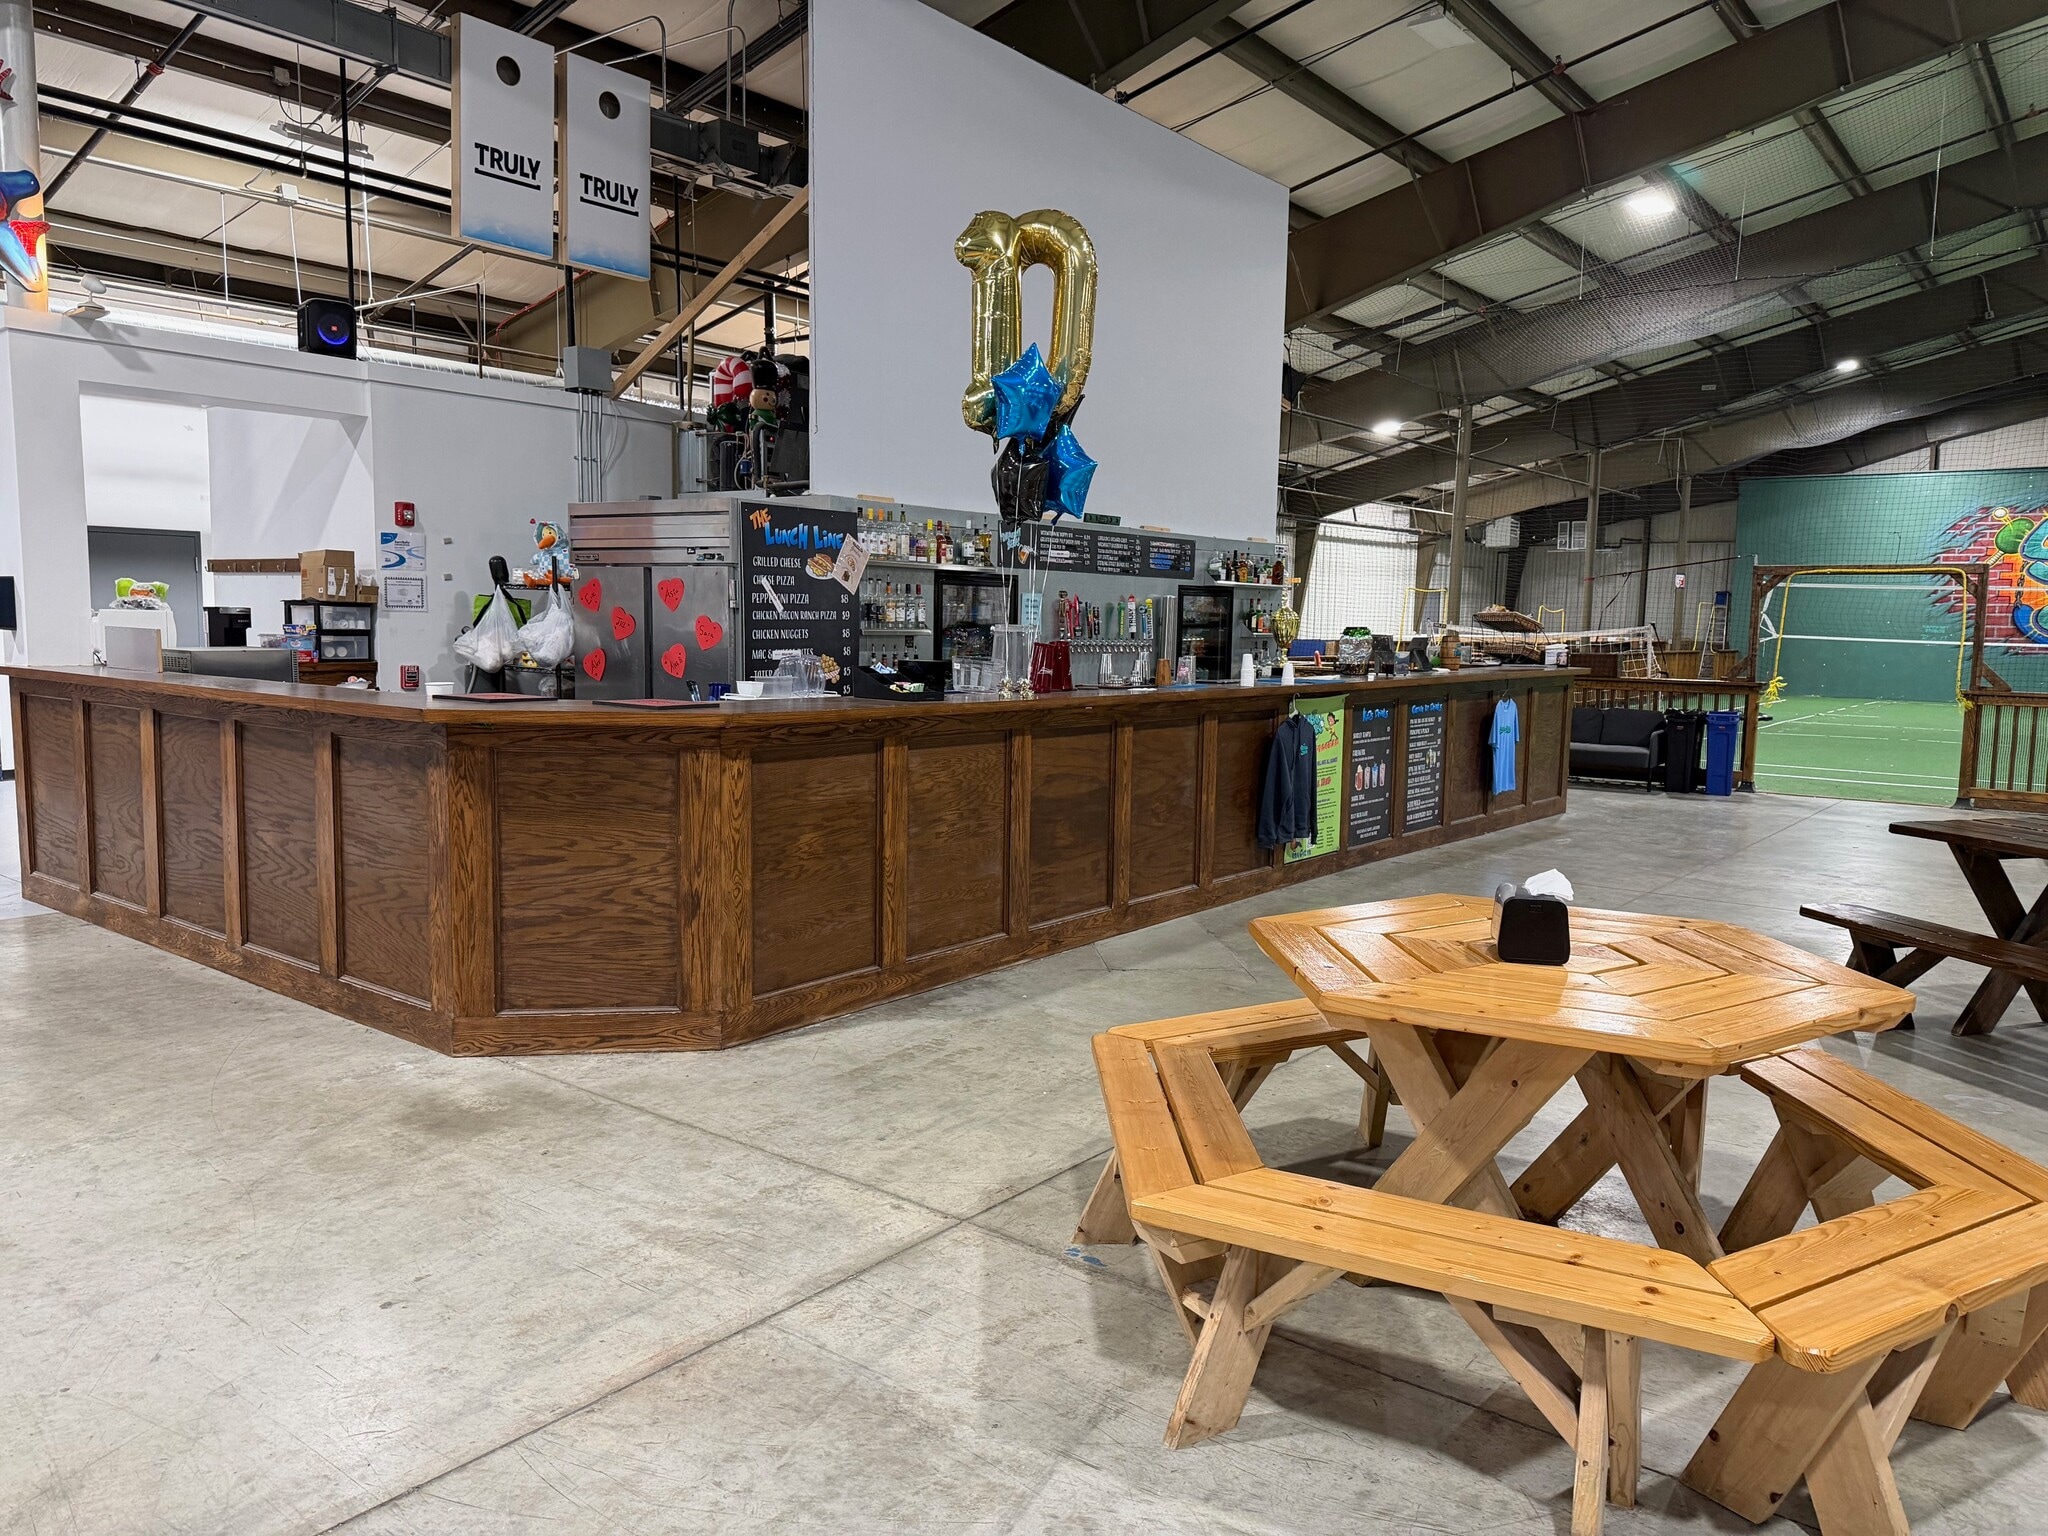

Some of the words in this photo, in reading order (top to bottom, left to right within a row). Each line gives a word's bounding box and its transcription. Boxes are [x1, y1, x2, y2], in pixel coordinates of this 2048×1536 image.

[474, 142, 541, 180] TRULY
[579, 172, 639, 207] TRULY
[749, 508, 772, 531] THE
[764, 521, 809, 551] LUNCH
[752, 556, 779, 568] GRILLED
[780, 557, 802, 569] CHEESE
[776, 575, 795, 586] PIZZA
[790, 593, 810, 605] PIZZA
[840, 594, 849, 604] $8
[752, 610, 778, 620] CHICKEN
[779, 611, 799, 620] BACON
[800, 611, 820, 620] RANCH
[820, 610, 837, 620] PIZZA
[841, 610, 850, 621] $9
[752, 629, 780, 640] CHICKEN
[780, 628, 809, 640] NUGGETS
[842, 628, 851, 638] $8
[751, 648, 766, 660] MAC
[843, 646, 851, 656] $8
[843, 666, 851, 676] $5
[842, 684, 851, 695] $5
